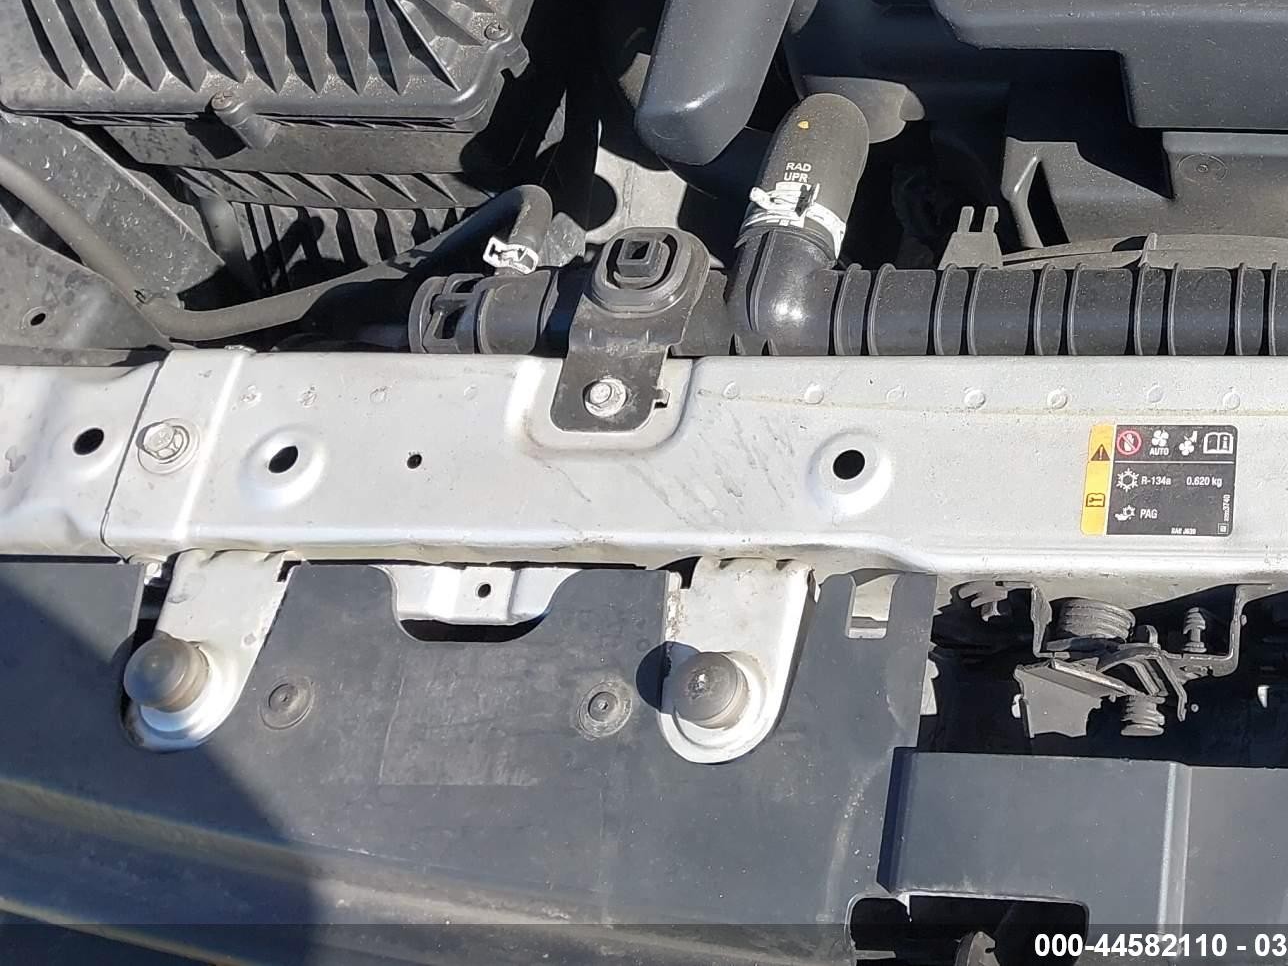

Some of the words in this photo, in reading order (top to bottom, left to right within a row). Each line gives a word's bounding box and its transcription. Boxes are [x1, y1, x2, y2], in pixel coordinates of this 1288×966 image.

[785, 162, 812, 172] RAD
[783, 172, 808, 182] UPR
[1149, 447, 1169, 455] AUTO
[1141, 476, 1172, 485] R-134a
[1186, 476, 1211, 486] 0.620
[1211, 476, 1223, 488] kg
[1139, 509, 1158, 519] PAG
